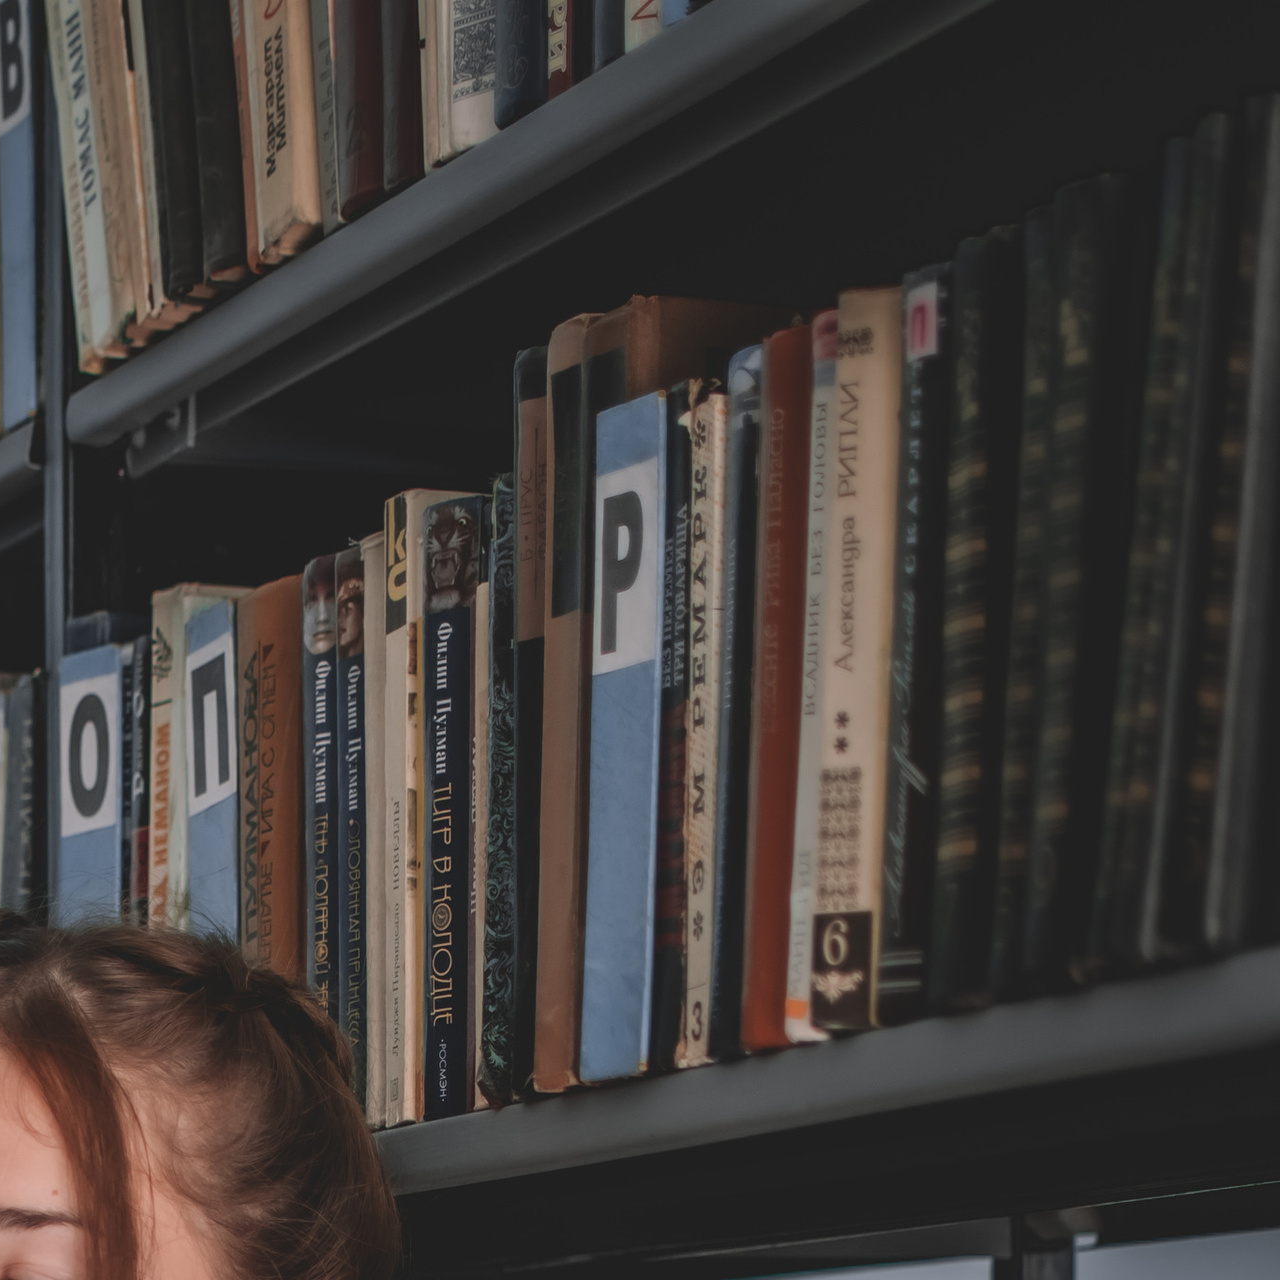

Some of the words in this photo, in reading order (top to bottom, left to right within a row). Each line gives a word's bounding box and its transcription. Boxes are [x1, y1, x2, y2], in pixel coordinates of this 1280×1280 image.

[64, 10, 87, 101] МАНН
[263, 37, 276, 179] Маргарет
[274, 25, 288, 152] Митчелл
[74, 108, 97, 216] ТОМАС
[814, 401, 828, 512] ГОЛОВЫ
[838, 381, 860, 499] РИПЛИ
[520, 468, 533, 525] ПРУС
[600, 490, 643, 656] Р
[675, 502, 688, 636] ТОВАРИЩА
[690, 464, 708, 733] РЕМАРК
[810, 529, 824, 578] БЕЗ
[834, 513, 863, 673] Александра
[315, 660, 331, 725] Филип
[347, 664, 361, 730] Филип
[436, 622, 453, 689] Филип
[673, 642, 685, 687] ТРИ
[804, 589, 821, 717] ВСАДНИК
[191, 652, 231, 798] П
[261, 663, 277, 740] ОГНЕМ
[434, 696, 452, 775] Пулман
[69, 693, 109, 818] О
[154, 720, 172, 866] НЕМАНОМ
[241, 648, 259, 943] ПУЙМАНОВА
[261, 747, 274, 768] С
[312, 731, 331, 804] Пулман
[347, 736, 362, 812] Пулман
[261, 773, 275, 832] ИГРА
[314, 812, 329, 855] ТЕНЬ
[392, 800, 401, 890] НОВЕЛЛЫ
[432, 782, 452, 845] ТИГР
[347, 818, 361, 942] ОЛОВЯННАЯ
[432, 855, 452, 875] В
[391, 902, 400, 992] Пиранделло
[431, 882, 453, 1027] КОЛОДЦЕ
[822, 918, 850, 967] 6
[347, 946, 361, 1048] ПРИНЦЕССА
[391, 997, 400, 1057] Луиджи
[691, 1001, 703, 1041] 3
